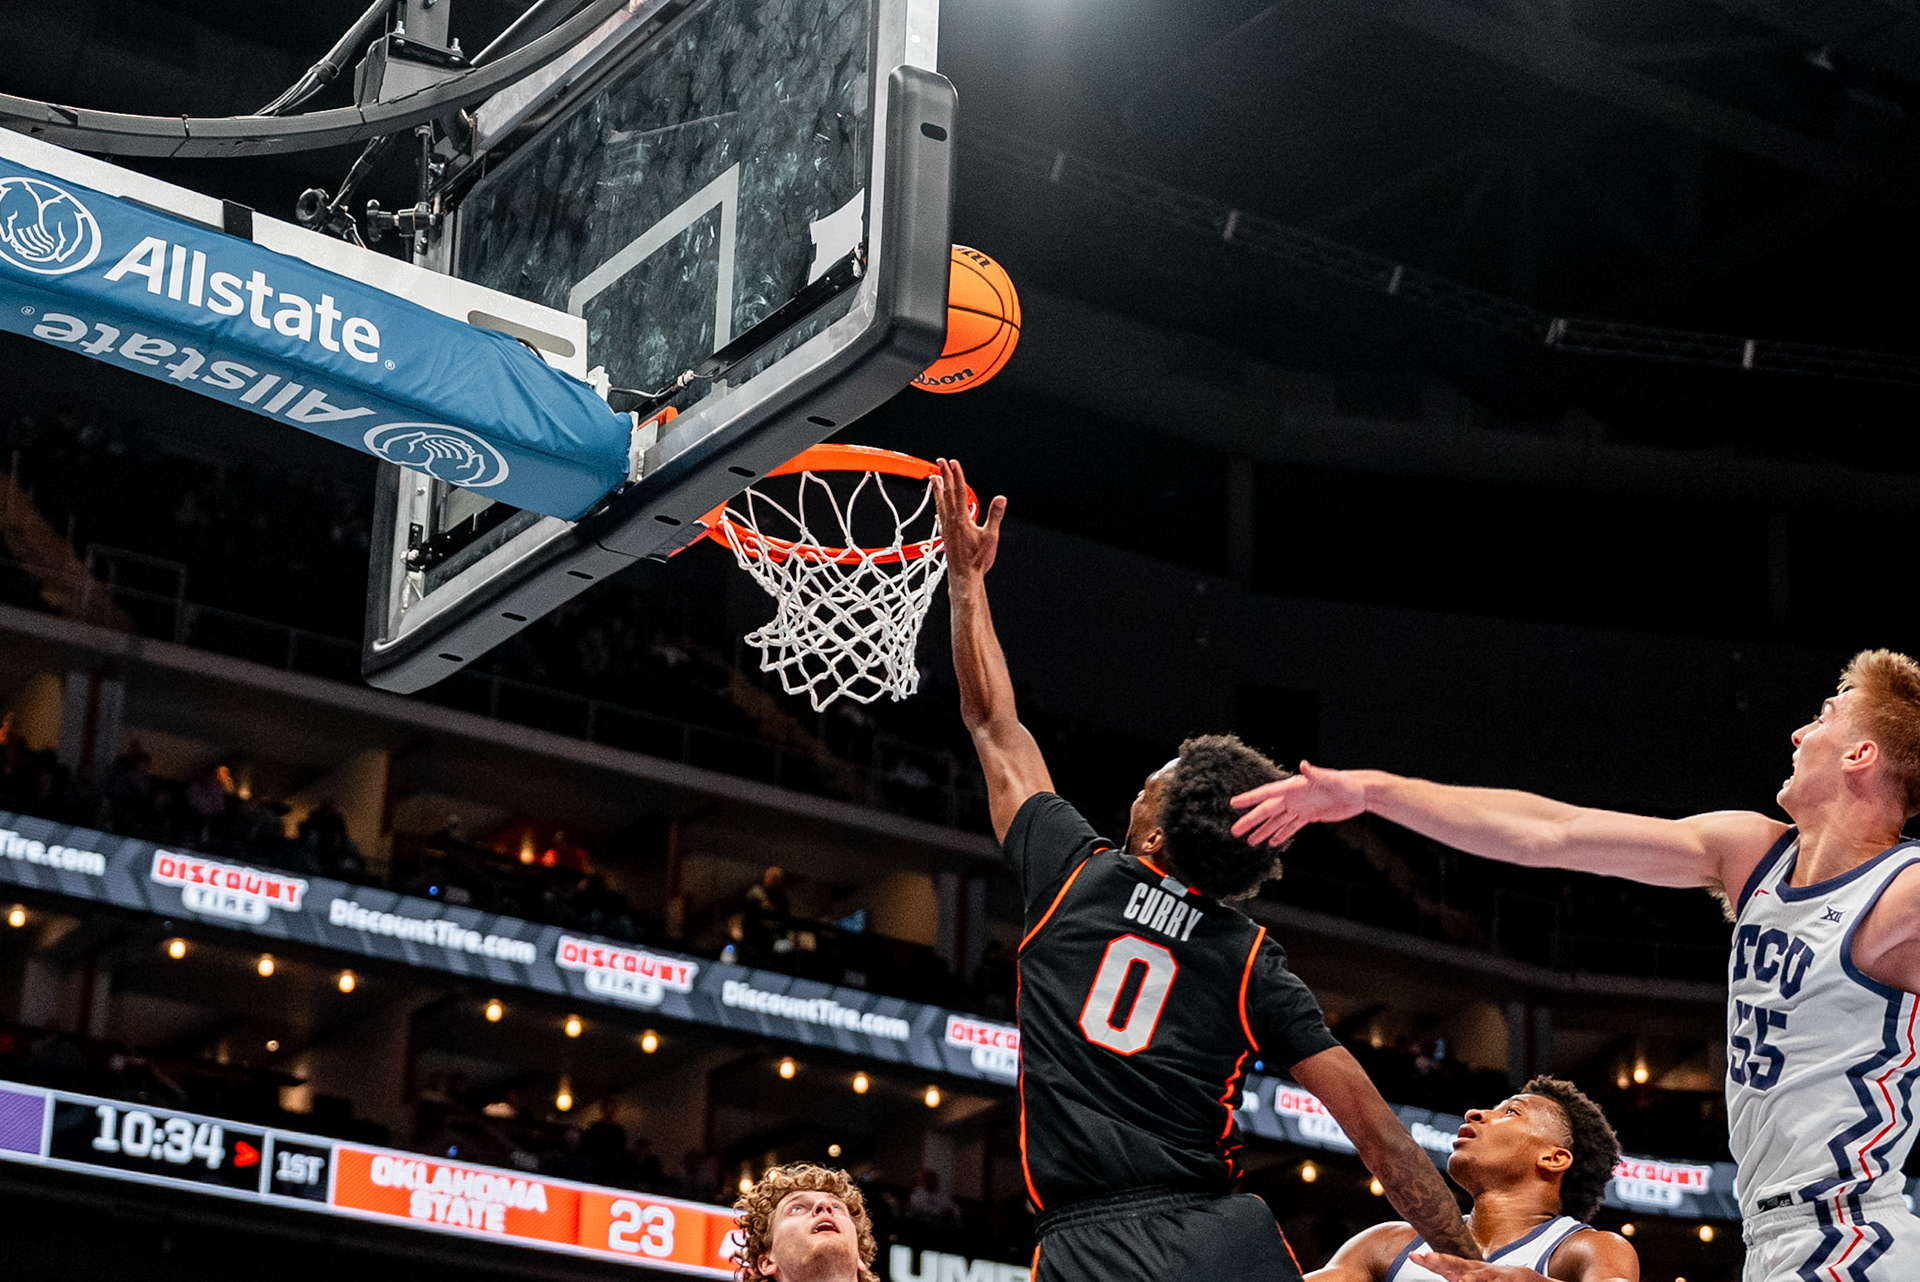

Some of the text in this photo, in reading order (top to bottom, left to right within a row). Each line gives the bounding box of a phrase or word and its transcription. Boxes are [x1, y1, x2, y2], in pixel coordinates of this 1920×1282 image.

[104, 236, 381, 364] Allstate
[33, 312, 376, 424] Allstate
[154, 852, 302, 908] DISCOUNT
[194, 886, 258, 914] TIRE
[330, 898, 537, 965] DiscountTire.com
[1123, 882, 1204, 941] CURRY
[559, 939, 693, 988] DISCOUNT
[595, 970, 652, 997] TIRE
[1733, 924, 1815, 1000] TCU
[722, 979, 910, 1042] DiscountTire.com
[1078, 933, 1179, 1056] 0
[1730, 999, 1788, 1091] 55
[92, 1105, 225, 1169] 10:34
[276, 1151, 325, 1185] 1ST
[370, 1155, 548, 1213] OKLAHOMA
[409, 1190, 506, 1233] STATE
[609, 1199, 674, 1257] 23
